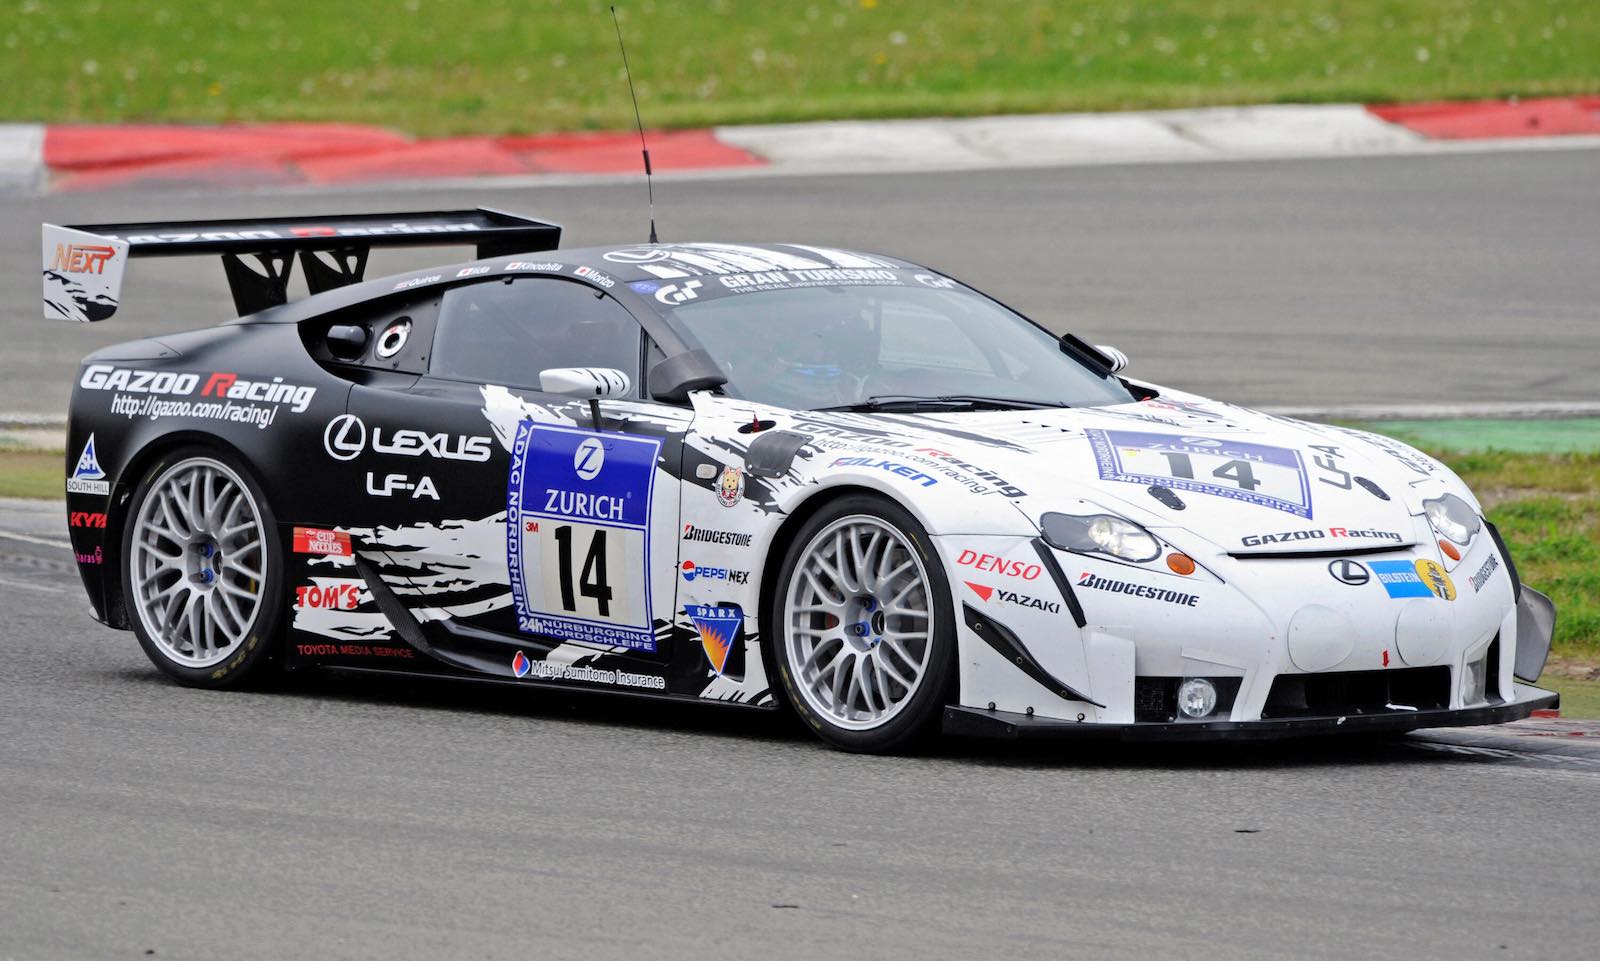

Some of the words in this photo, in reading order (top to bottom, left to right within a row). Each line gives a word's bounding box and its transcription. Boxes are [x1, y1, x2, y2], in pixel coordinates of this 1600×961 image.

[51, 242, 115, 274] NEXT
[586, 269, 616, 288] Morizo
[719, 271, 790, 288] GRAN
[788, 268, 898, 281] TURISMO
[80, 364, 200, 395] GAZOO
[200, 372, 317, 413] Racing
[110, 393, 278, 429] http://gazoo.com/racing/
[371, 427, 492, 462] LEXUS
[511, 425, 528, 485] ADAC
[790, 422, 914, 449] GAZOO
[913, 446, 1029, 499] Racing
[827, 456, 939, 488] FALKEN
[1160, 452, 1261, 491] 14
[68, 480, 92, 491] SOUTH
[93, 482, 109, 494] HILL
[366, 472, 441, 500] LF-A
[544, 489, 625, 520] ZURICH
[526, 521, 539, 533] 3M
[683, 523, 753, 547] BRIDGESTONE
[1241, 529, 1326, 547] GAZOO
[1328, 527, 1403, 543] Racing
[508, 491, 526, 615] NORDRHEIN
[956, 549, 1042, 581] DENSO
[555, 525, 613, 617] 14
[694, 566, 728, 580] PEPSI
[728, 569, 750, 585] NEX
[1377, 572, 1422, 584] BILSTEIN
[296, 584, 359, 609] TOM'S
[997, 589, 1061, 615] YAZAKI
[1076, 572, 1200, 608] BRIDGESTONE
[696, 607, 736, 618] SPARX
[519, 616, 543, 633] 24h
[542, 620, 652, 642] NÜRBURGRING
[543, 627, 653, 650] NORDSCHLEIFE
[297, 644, 339, 655] TOYOTA
[340, 645, 372, 655] MEDIA
[372, 646, 415, 658] SERVICE
[531, 660, 564, 680] Mitsui
[565, 664, 615, 684] Sumitomo
[615, 669, 665, 689] Insurance
